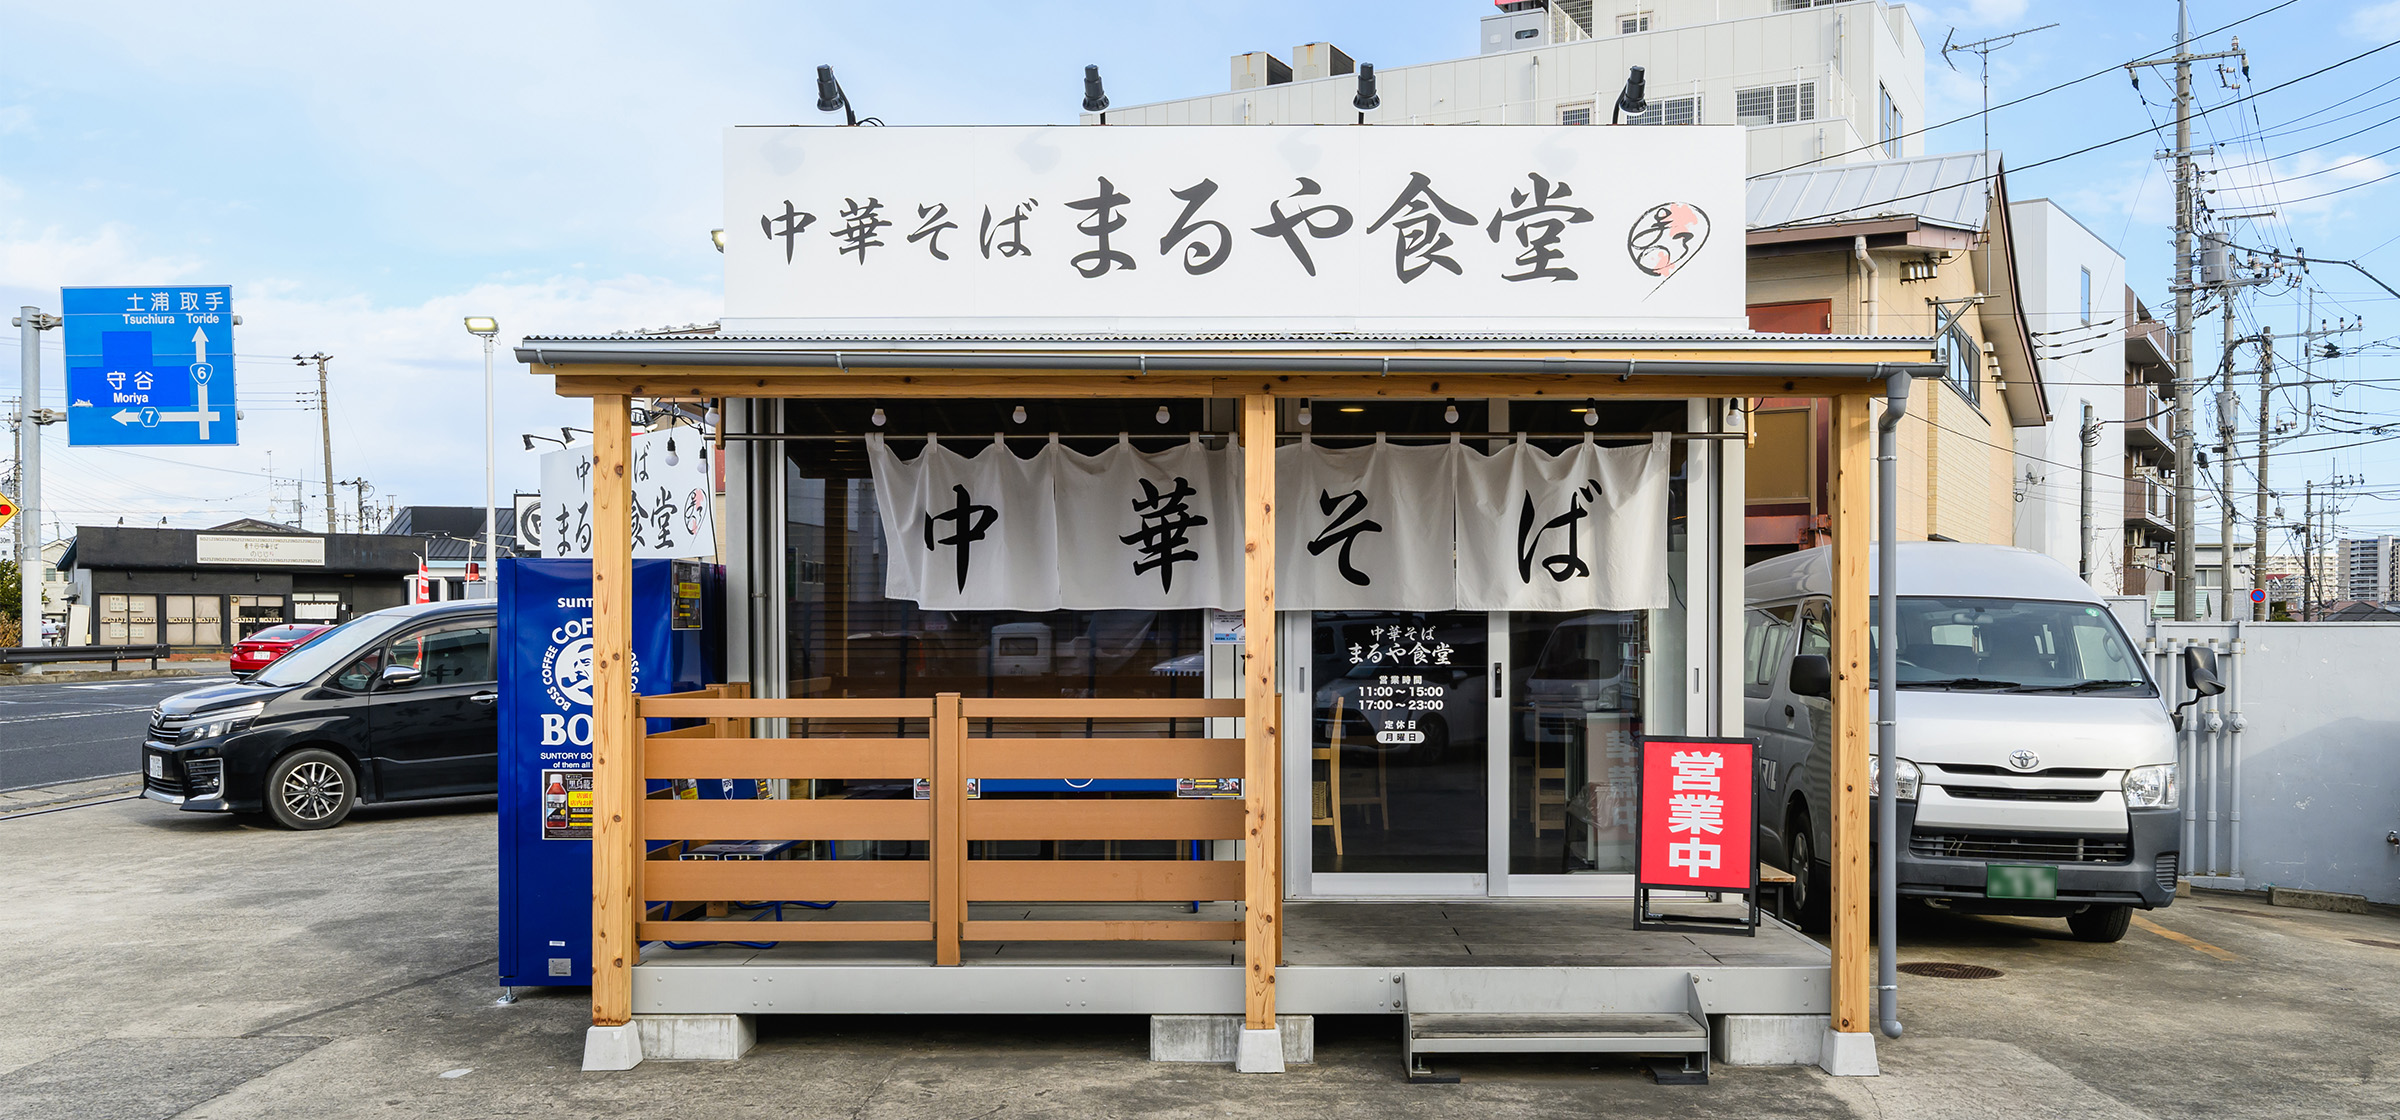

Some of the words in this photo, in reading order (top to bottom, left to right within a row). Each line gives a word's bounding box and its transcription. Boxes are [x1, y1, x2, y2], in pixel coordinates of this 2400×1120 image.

[761, 197, 1040, 266] 中華そば
[1062, 170, 1597, 284] まるや食堂
[126, 292, 170, 312] 土浦
[180, 292, 224, 311] 取手
[122, 313, 175, 325] Tsuchiura
[186, 313, 220, 324] Toride
[106, 370, 154, 391] 守谷
[197, 366, 207, 380] 6
[113, 392, 149, 405] Moriya
[145, 410, 154, 424] 7
[924, 476, 1604, 596] 中華そば
[557, 596, 593, 608] SUNT
[551, 617, 593, 645] COF
[1370, 625, 1436, 642] 中華そば
[1348, 642, 1455, 665] まるや食堂
[541, 644, 559, 686] COFFEE
[1379, 675, 1423, 685] 営業時間
[547, 686, 572, 712] BOSS
[540, 713, 593, 746] BO
[1384, 720, 1417, 730] 定休日
[1385, 733, 1417, 742] 月曜日
[540, 752, 579, 760] SUNTORY
[580, 752, 593, 760] BO
[1668, 750, 1724, 878] 営業中
